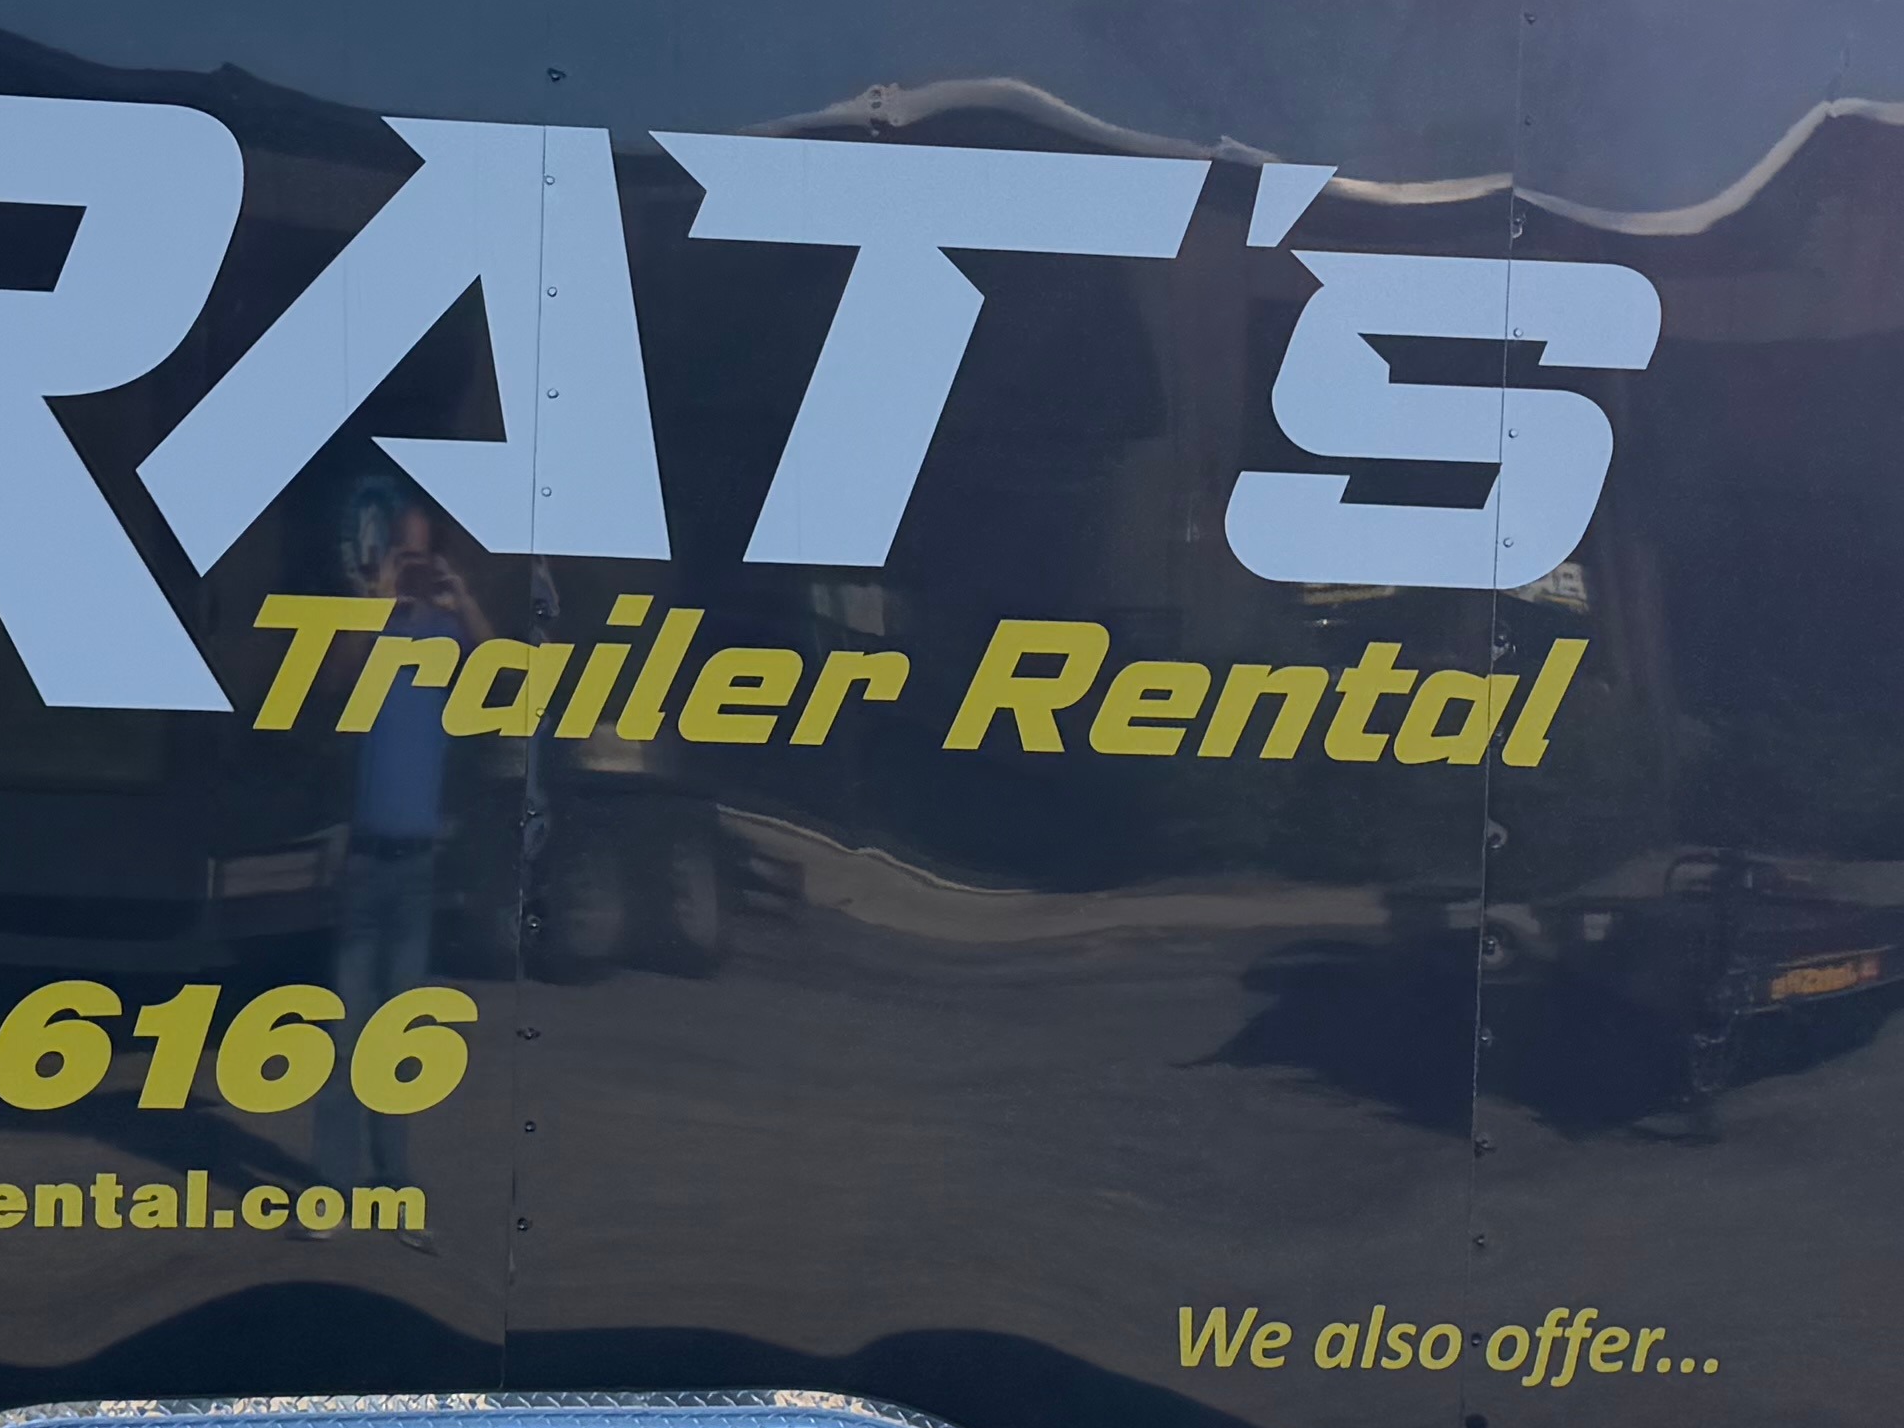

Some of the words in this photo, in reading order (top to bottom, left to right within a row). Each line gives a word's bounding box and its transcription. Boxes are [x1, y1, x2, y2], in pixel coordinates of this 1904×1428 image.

[254, 594, 910, 747] Trailer
[944, 620, 1588, 769] Rental
[1180, 1307, 1293, 1370] We
[1315, 1306, 1463, 1371] also
[1487, 1308, 1720, 1389] offer...
